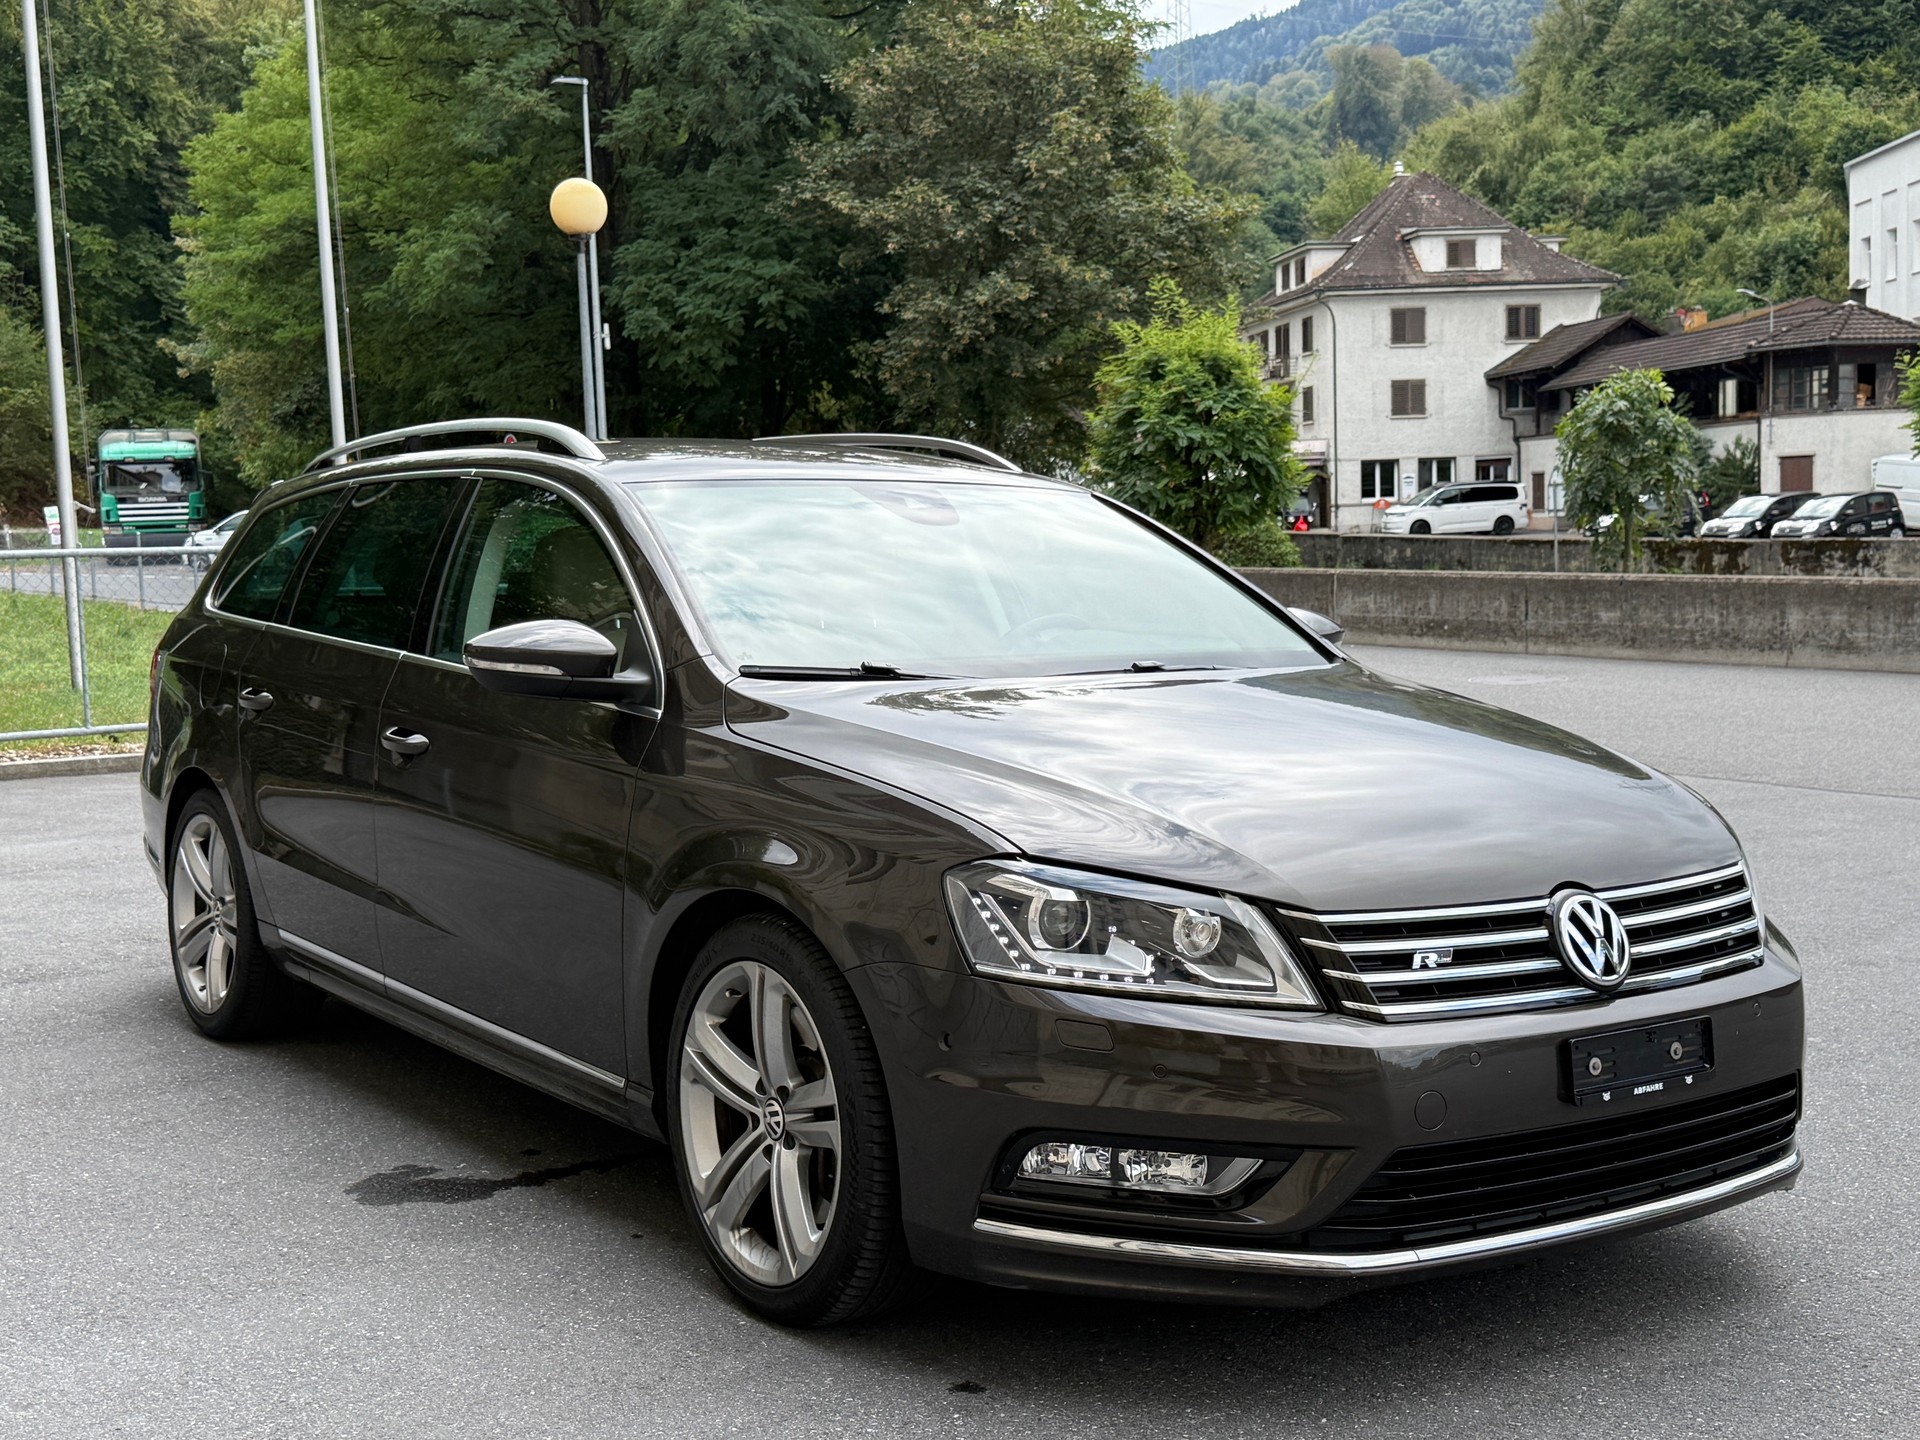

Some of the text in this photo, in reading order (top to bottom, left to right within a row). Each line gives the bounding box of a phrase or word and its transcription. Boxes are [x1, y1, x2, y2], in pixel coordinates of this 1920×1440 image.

[1563, 894, 1629, 984] VW
[1412, 953, 1438, 969] R
[1633, 1082, 1664, 1095] ABFAHRE
